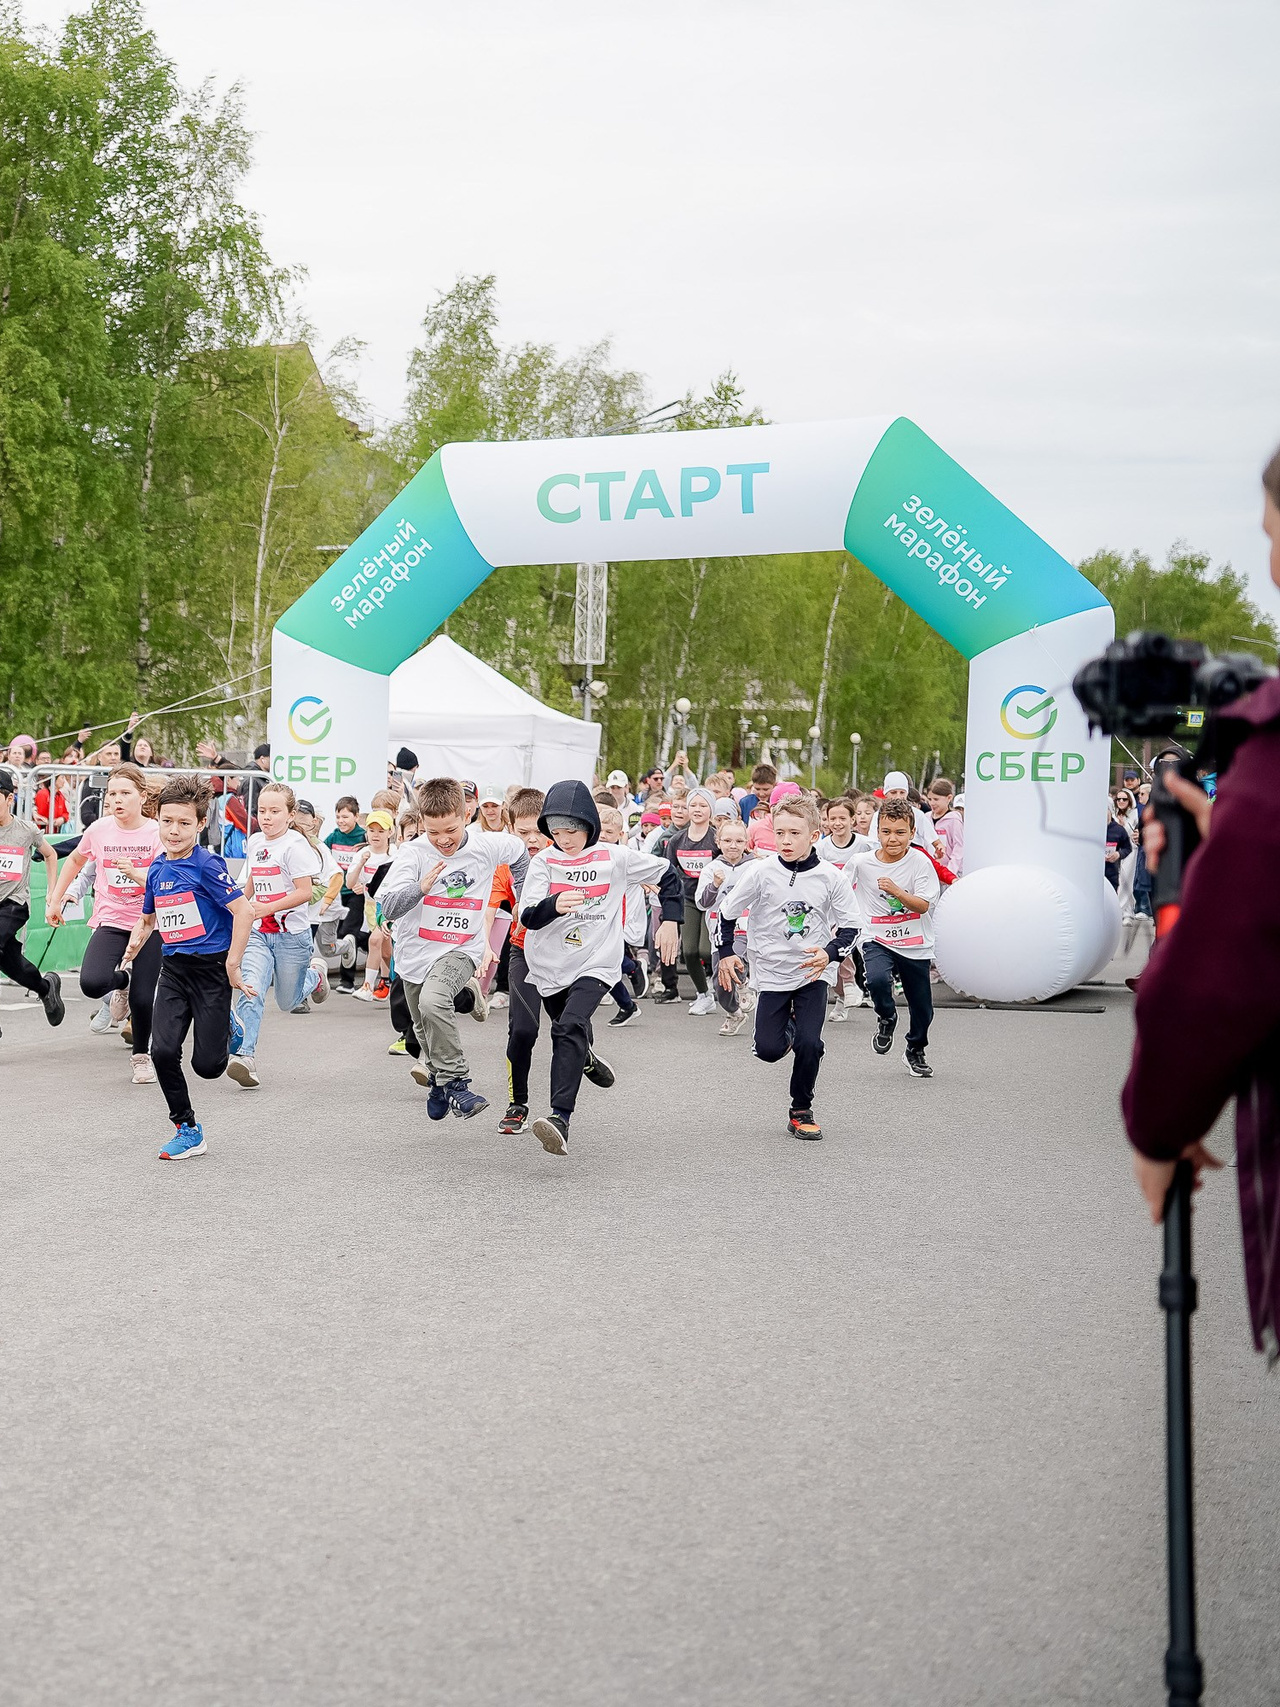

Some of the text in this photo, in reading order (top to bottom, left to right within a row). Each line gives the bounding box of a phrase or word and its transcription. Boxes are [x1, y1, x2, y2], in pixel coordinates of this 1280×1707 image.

[536, 462, 770, 524] СТАРТ
[902, 494, 1013, 591] зелёный
[330, 518, 417, 612] зелёный
[883, 512, 988, 610] марафон
[344, 537, 433, 630] марафон
[273, 755, 357, 784] СБЕР
[976, 751, 1085, 782] СБЕР
[254, 882, 272, 892] 2711
[565, 870, 597, 883] 2700
[161, 913, 186, 928] 2772
[437, 915, 469, 930] 2758
[885, 927, 910, 938] 2814
